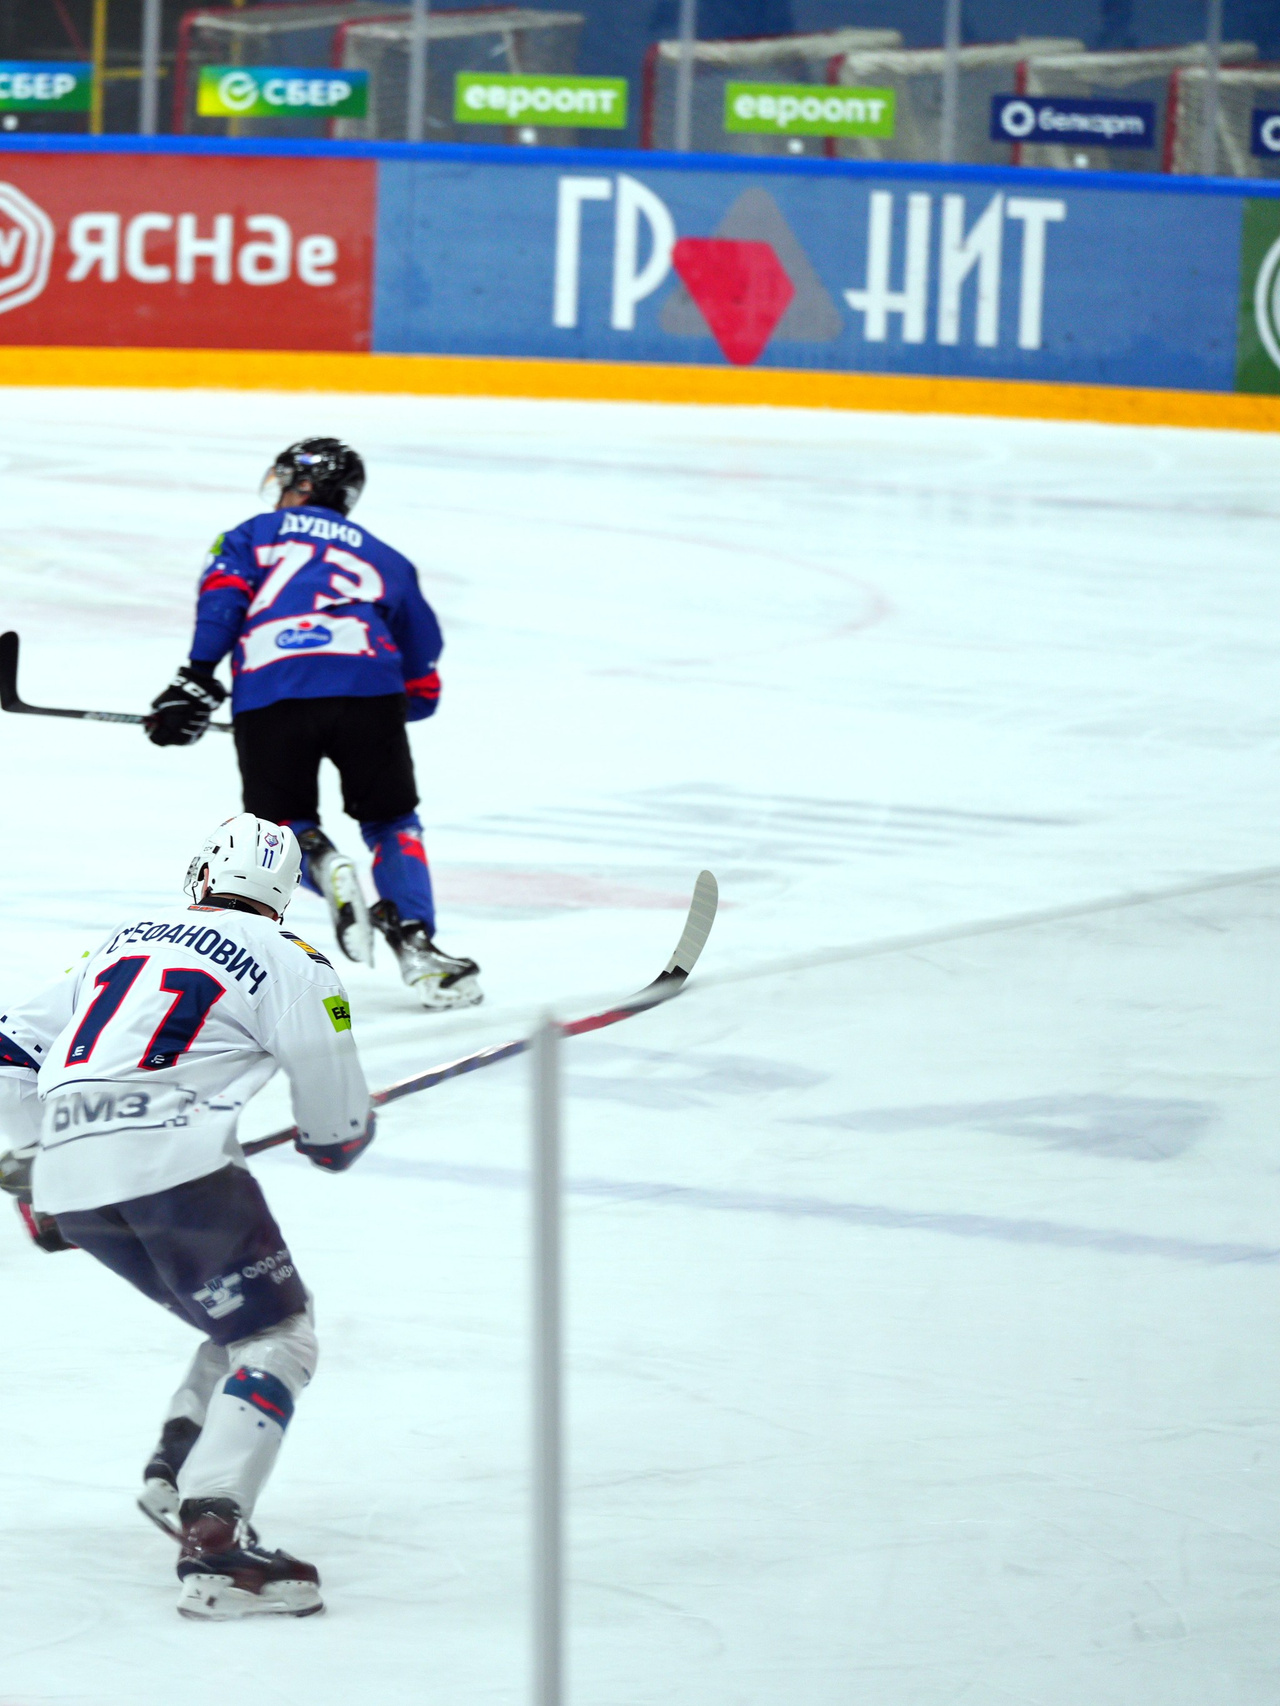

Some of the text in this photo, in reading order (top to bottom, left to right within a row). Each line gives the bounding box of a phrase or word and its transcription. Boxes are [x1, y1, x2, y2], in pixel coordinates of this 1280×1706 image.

[262, 79, 352, 107] СБЕР
[464, 83, 616, 117] евроопт
[733, 93, 886, 128] евроопт
[279, 512, 363, 548] ДУДКО
[247, 540, 385, 620] 73
[262, 847, 274, 869] 11
[106, 921, 268, 996] СЕФАНОВИЧ
[64, 955, 227, 1072] 11
